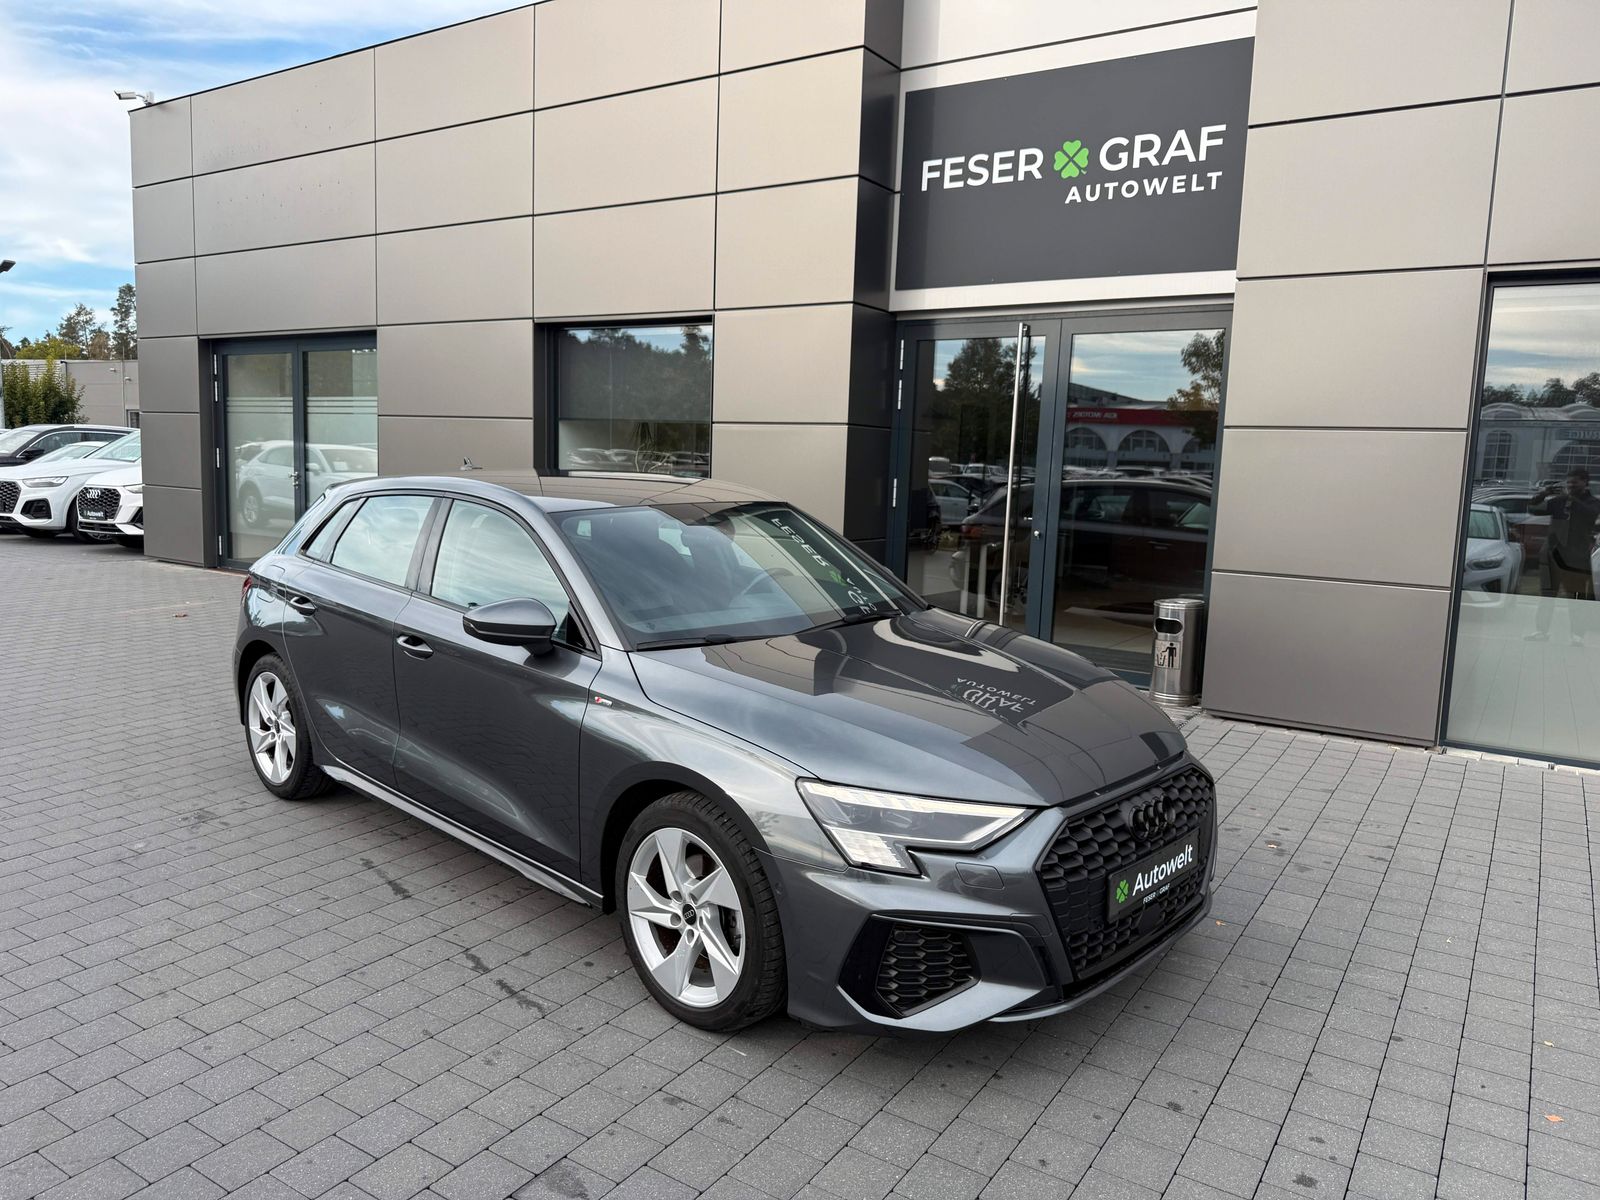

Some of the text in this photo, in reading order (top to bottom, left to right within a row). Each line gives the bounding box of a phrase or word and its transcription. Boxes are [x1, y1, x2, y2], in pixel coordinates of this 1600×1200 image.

[921, 124, 1227, 192] FESER GRAF
[1064, 171, 1223, 204] AUTOWELT
[1132, 844, 1193, 896] Autowelt
